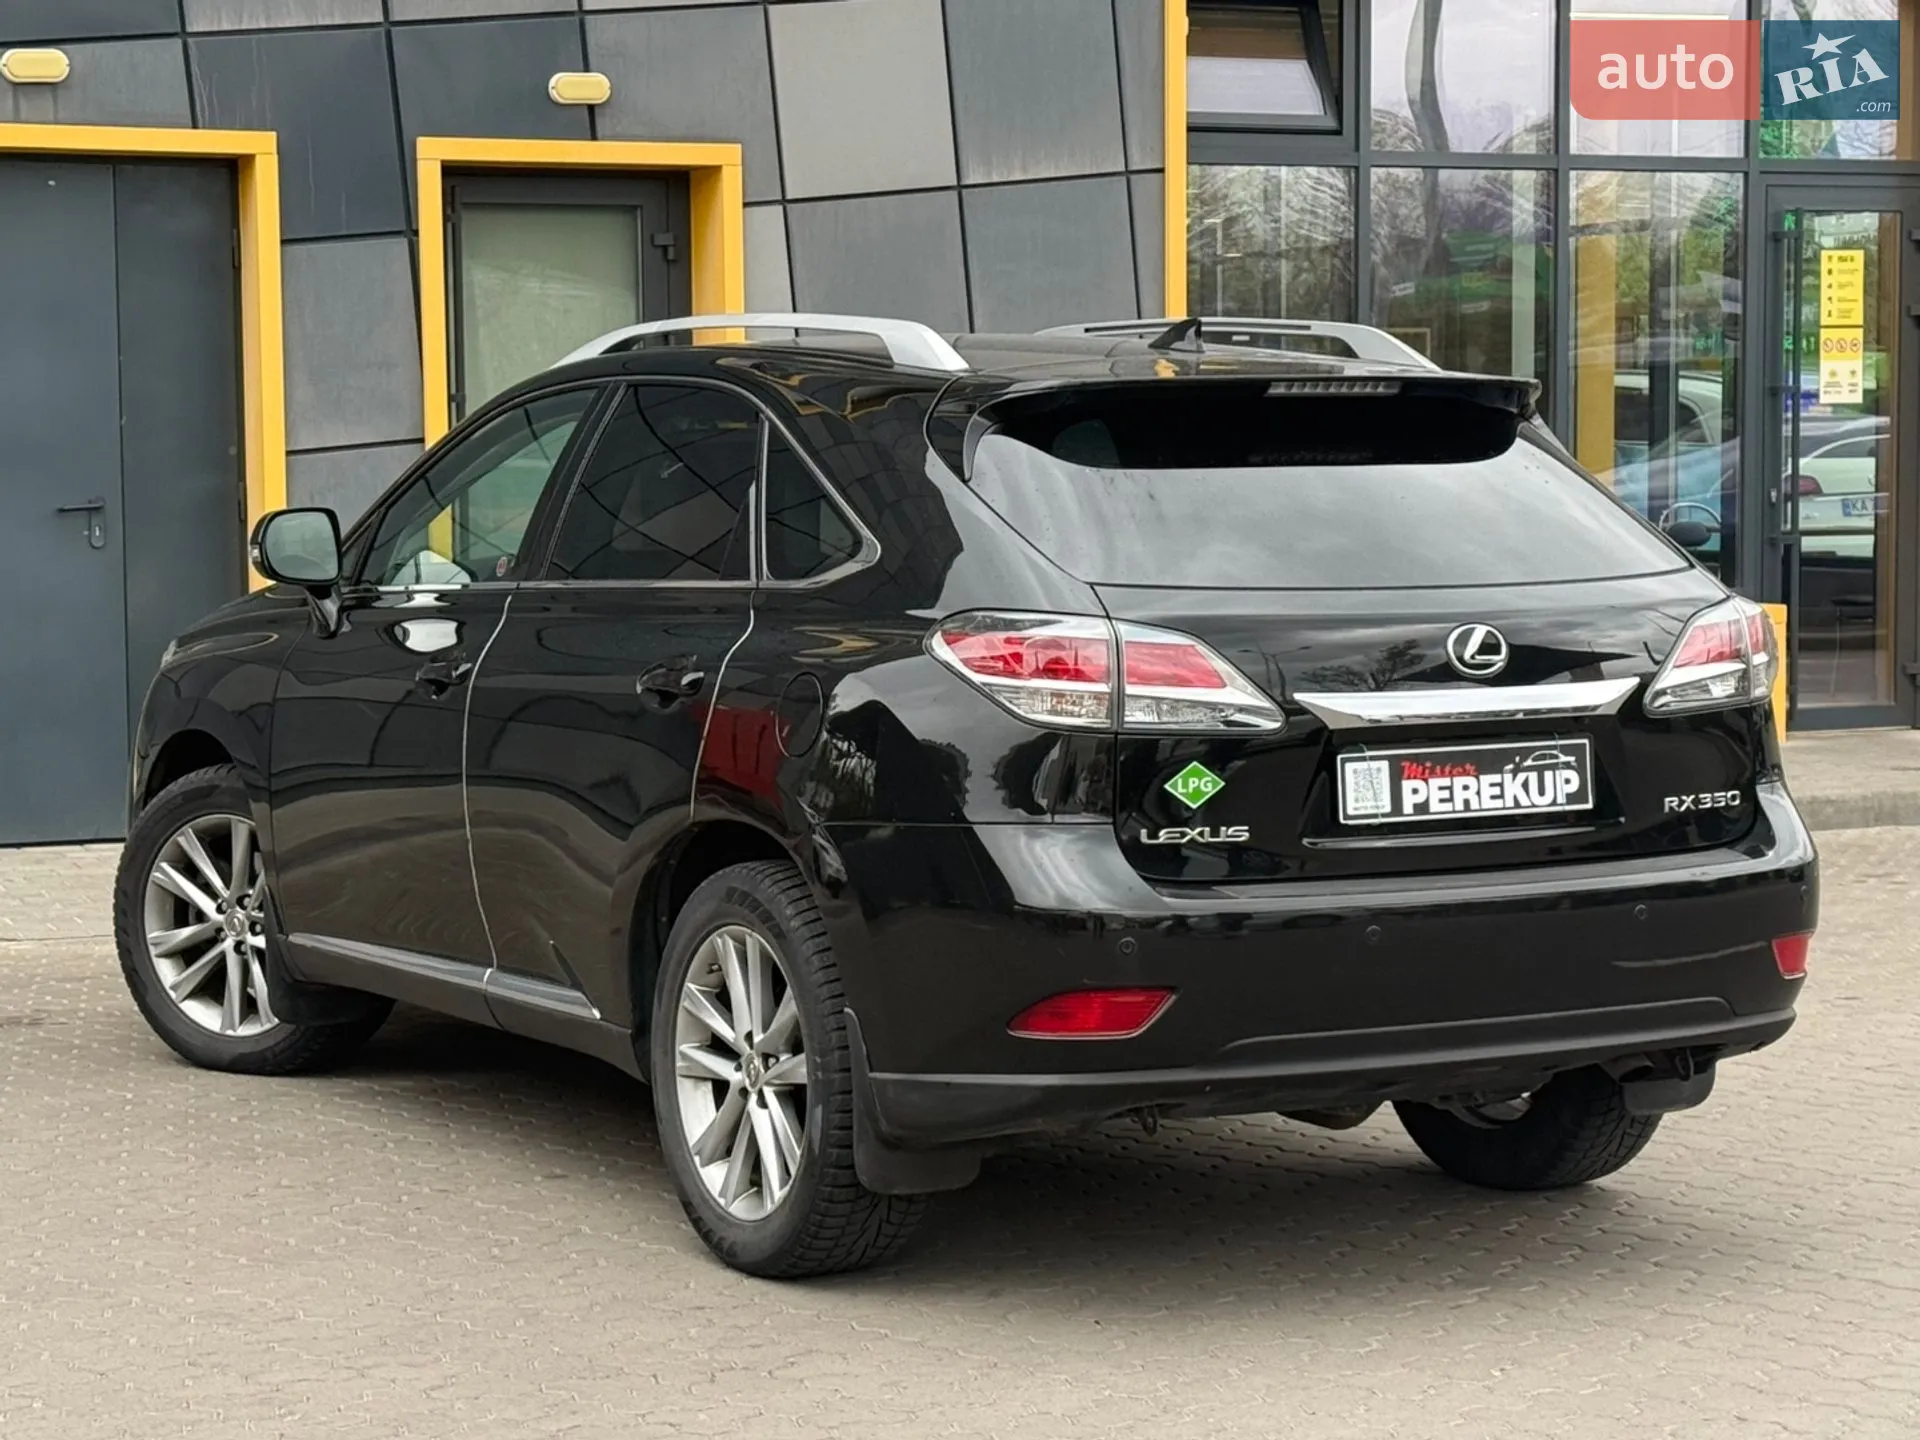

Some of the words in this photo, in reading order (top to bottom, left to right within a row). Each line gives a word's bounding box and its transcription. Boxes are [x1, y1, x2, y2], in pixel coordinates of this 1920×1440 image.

[1400, 760, 1478, 780] Mister
[1177, 777, 1213, 793] LPG
[1401, 769, 1580, 815] PEREKUP
[1139, 825, 1250, 844] LEXUS
